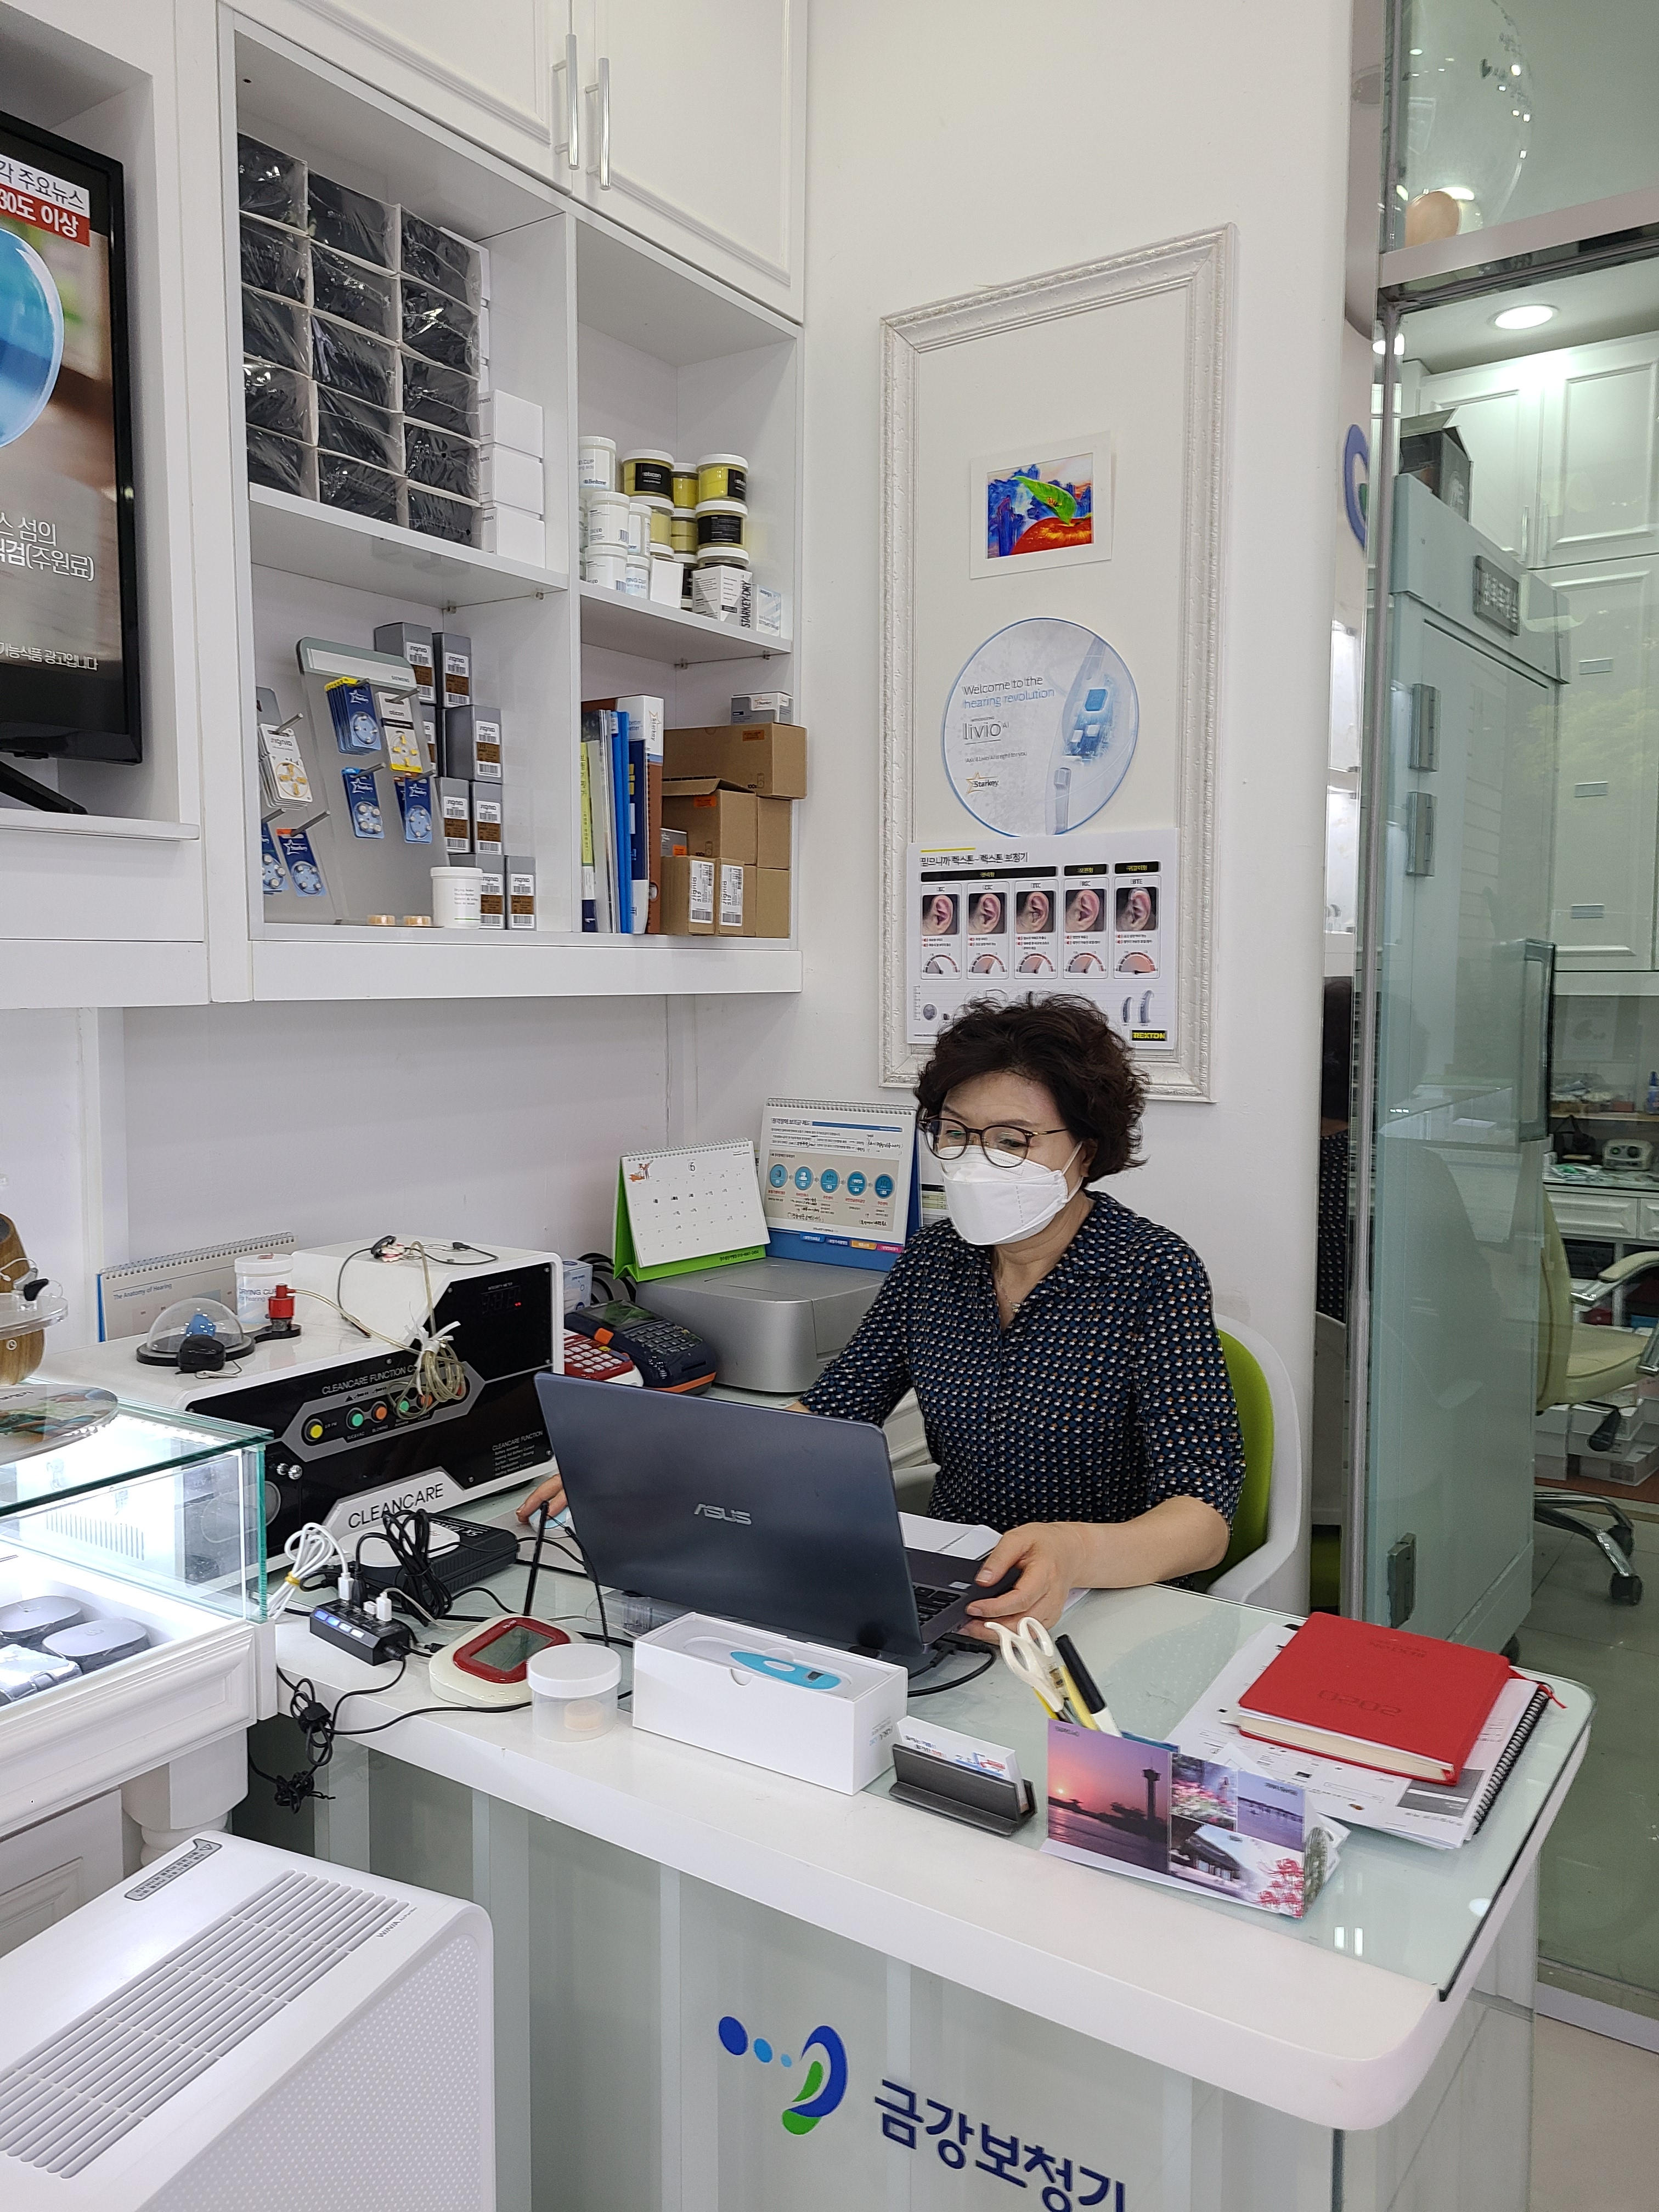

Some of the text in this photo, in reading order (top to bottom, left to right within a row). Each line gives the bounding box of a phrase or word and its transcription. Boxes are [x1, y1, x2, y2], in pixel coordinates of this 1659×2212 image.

[18, 168, 84, 210] 주요뉴스
[41, 205, 79, 238] 이상
[18, 517, 57, 546] 섬의
[963, 676, 1043, 695] Welcome to the
[963, 689, 1055, 709] hearing revolution
[973, 780, 999, 788] Starkey
[920, 856, 951, 867] 믿으니까
[951, 855, 974, 866] 렉스톤
[979, 854, 1003, 864] 렉스톤
[1003, 852, 1029, 863] 보청기
[689, 1161, 696, 1172] 6
[123, 1289, 146, 1300] Anatomy
[153, 1283, 172, 1293] Hearing
[321, 1366, 406, 1395] CLEANCARE FUNCTION
[372, 1425, 388, 1433] BLOWING
[492, 1430, 543, 1451] CLEANCARE FUNCTION
[348, 1483, 443, 1528] CLEANCARE
[694, 1504, 752, 1525] ASUS
[1319, 1689, 1401, 1716] 2020
[874, 2079, 1126, 2212] 금강보청기
